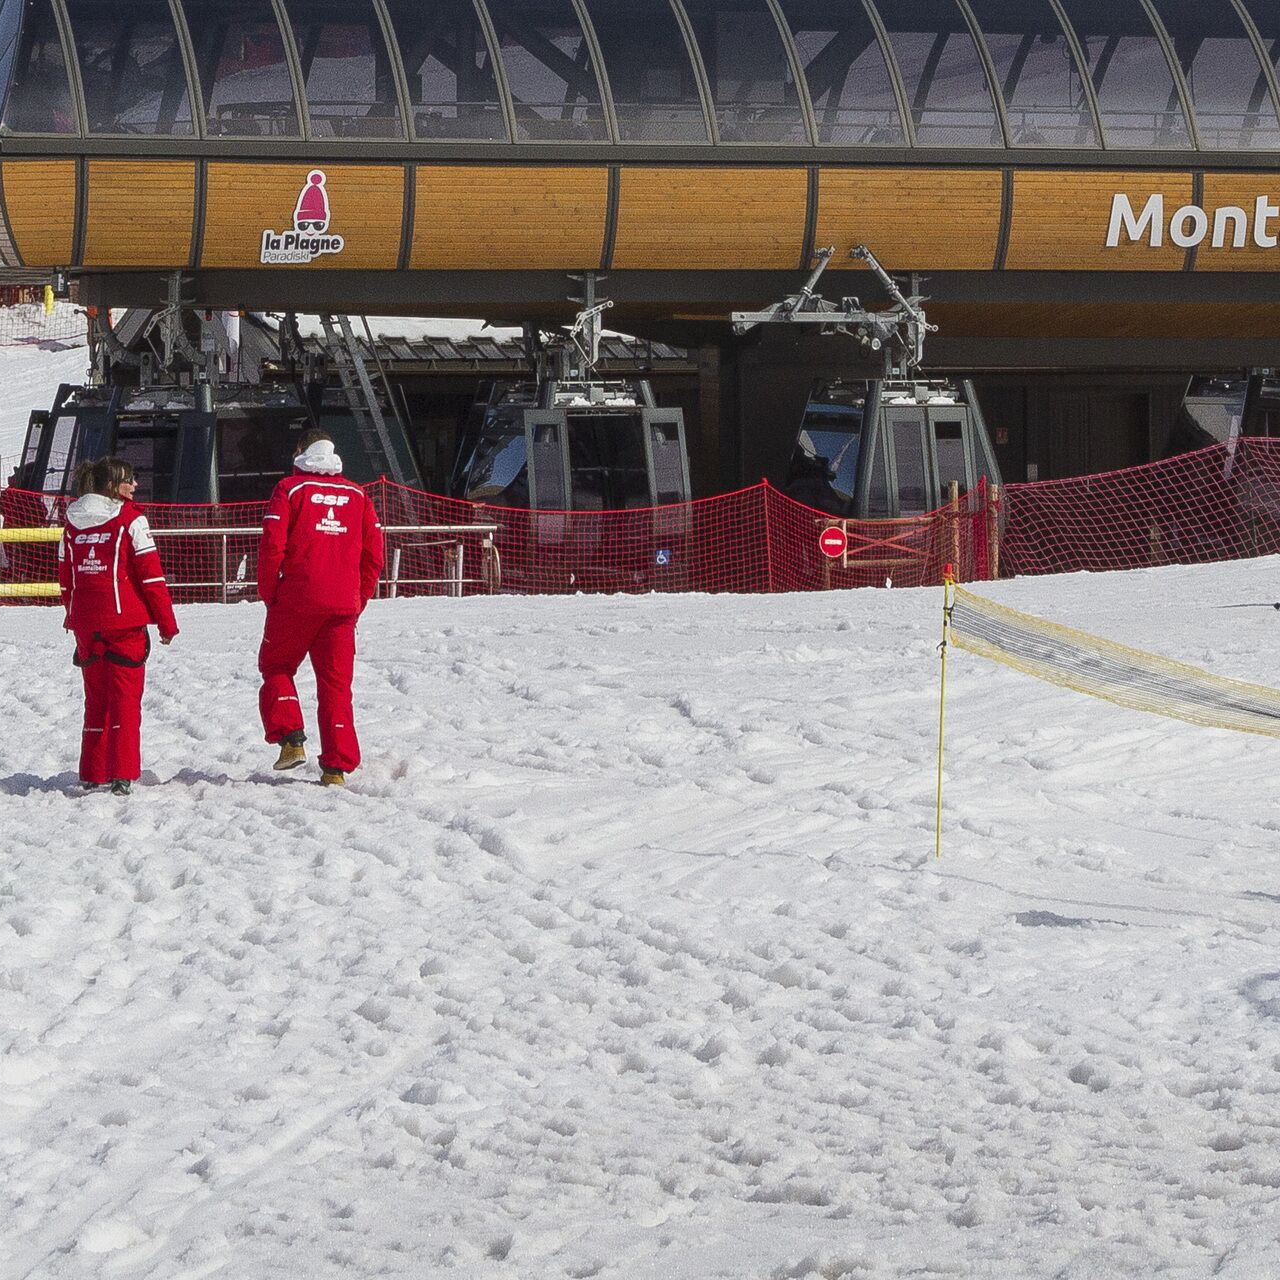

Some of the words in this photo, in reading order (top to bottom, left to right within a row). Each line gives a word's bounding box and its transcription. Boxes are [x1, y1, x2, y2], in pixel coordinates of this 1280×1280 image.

[265, 233, 281, 250] la
[284, 233, 341, 255] Plagne
[263, 251, 310, 261] Paradiski
